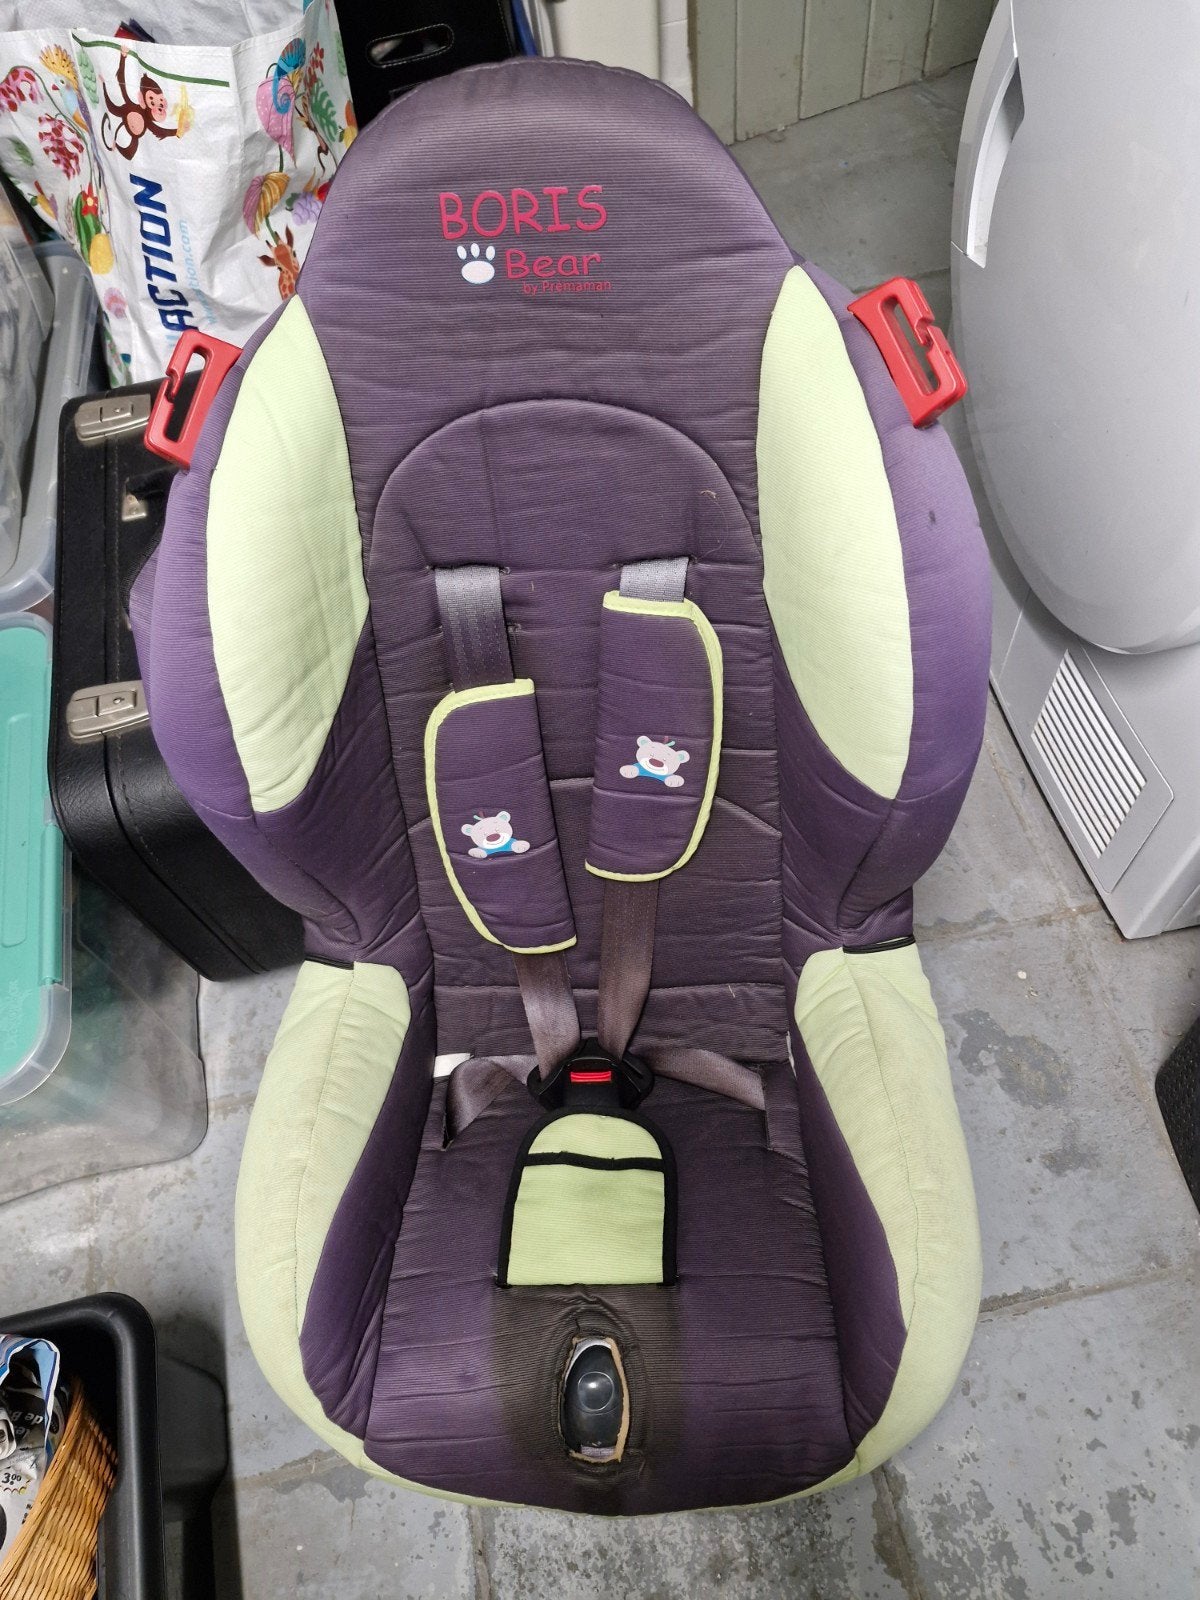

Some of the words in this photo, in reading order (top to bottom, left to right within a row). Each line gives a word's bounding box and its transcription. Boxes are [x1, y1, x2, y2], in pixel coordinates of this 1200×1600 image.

[439, 185, 607, 240] BORIS
[129, 173, 199, 332] ACTION
[505, 249, 602, 279] Bear
[523, 280, 538, 296] by
